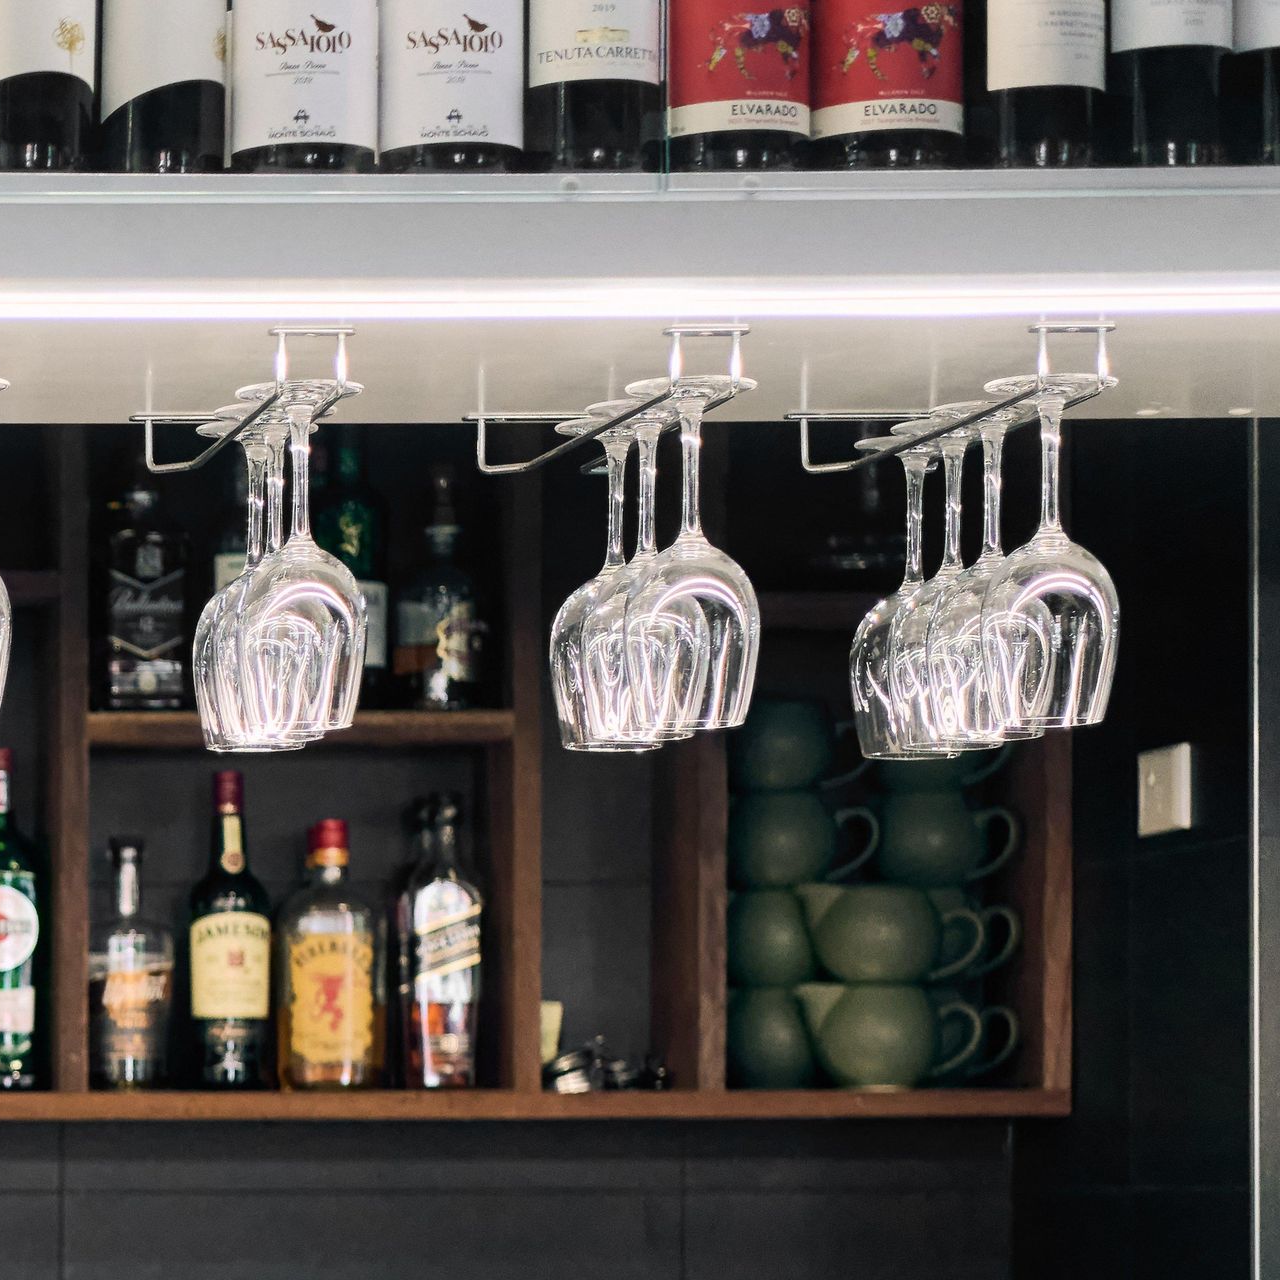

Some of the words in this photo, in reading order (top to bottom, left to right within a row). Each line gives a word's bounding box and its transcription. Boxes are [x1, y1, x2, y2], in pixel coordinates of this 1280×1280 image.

[536, 47, 592, 64] TENUTA
[731, 104, 798, 117] ELVARADO
[864, 103, 937, 116] ELVARADO
